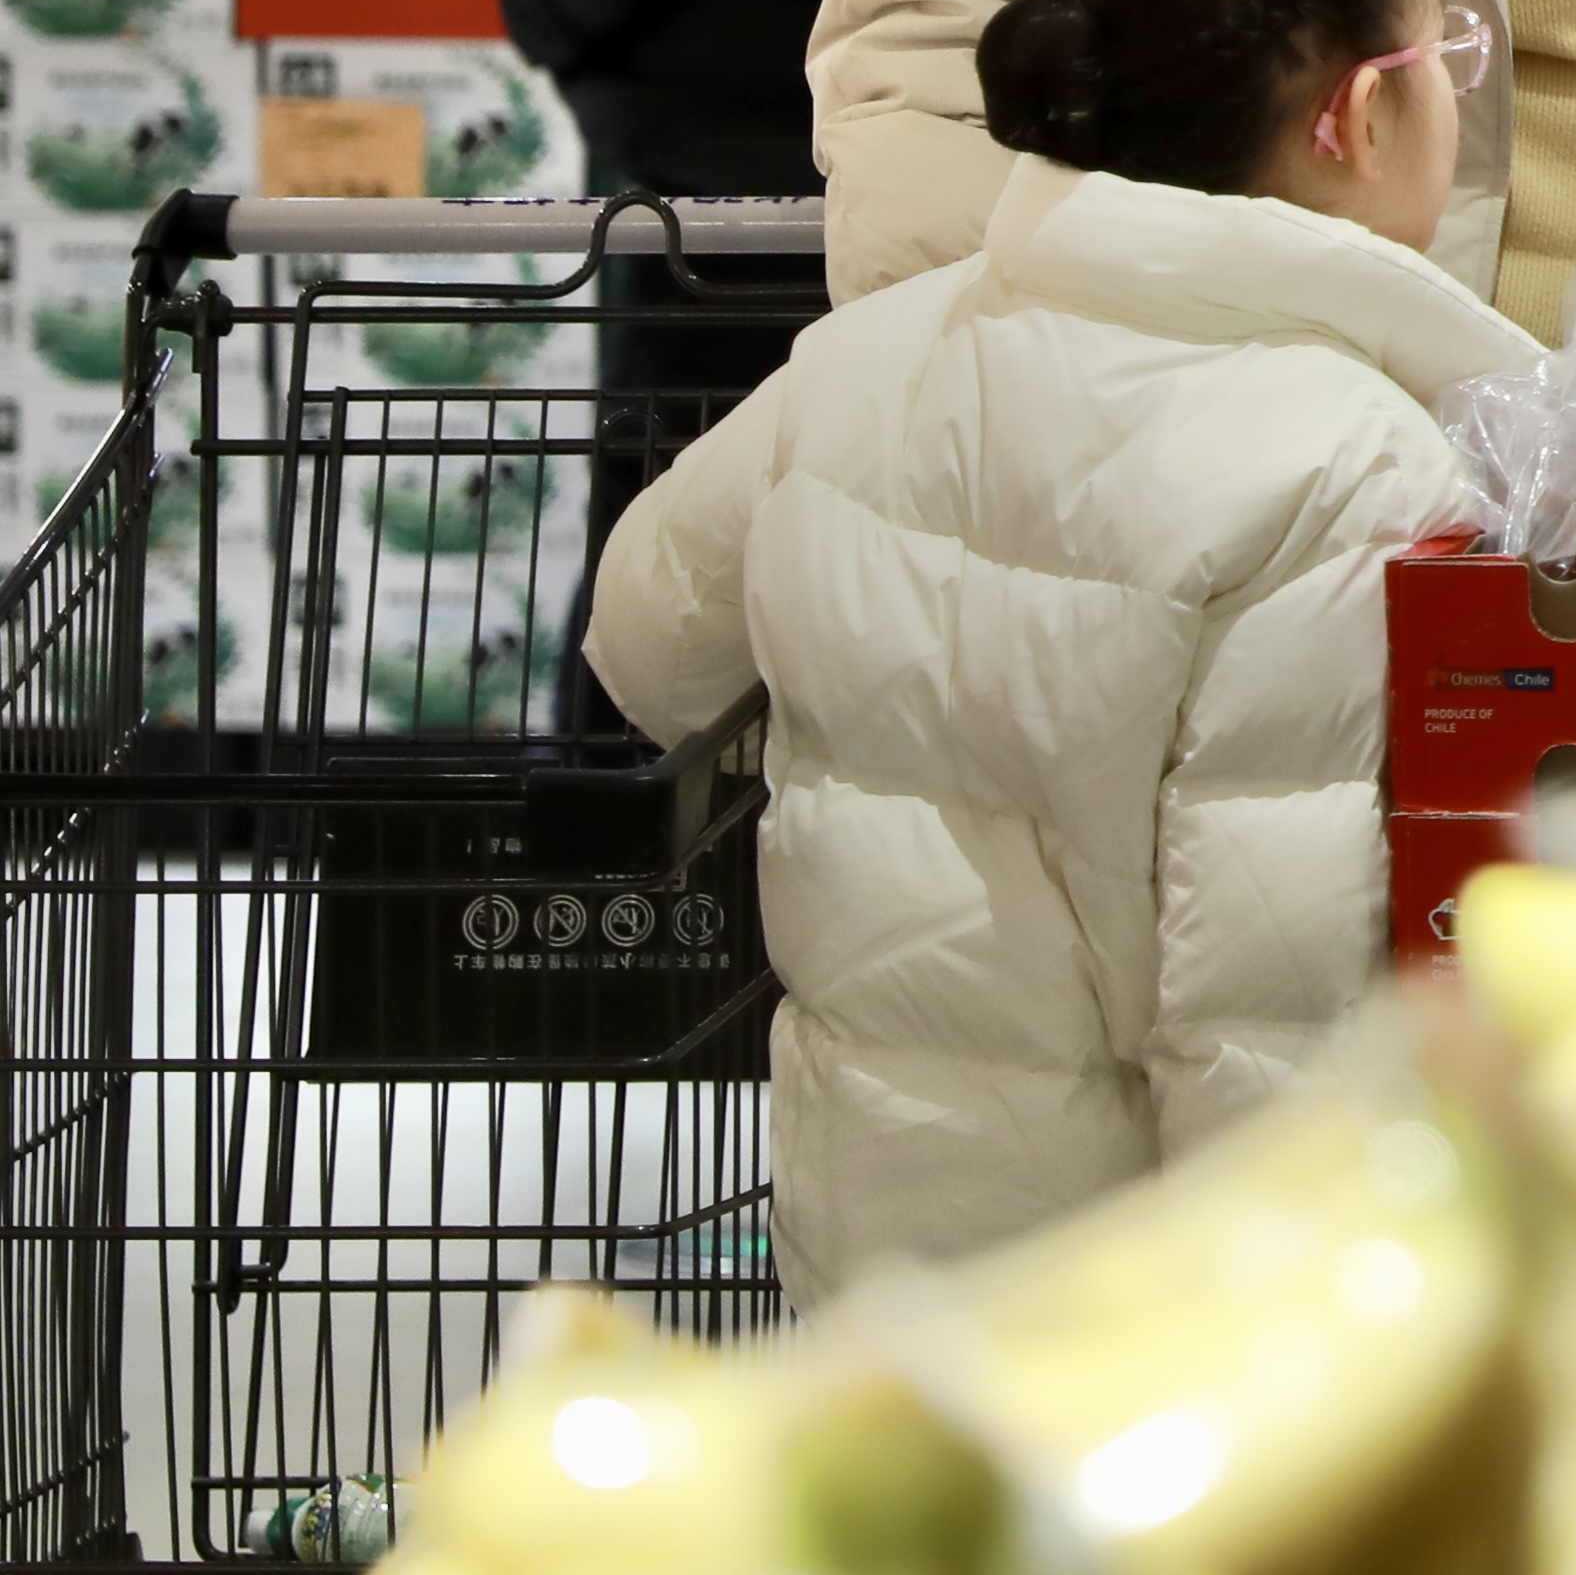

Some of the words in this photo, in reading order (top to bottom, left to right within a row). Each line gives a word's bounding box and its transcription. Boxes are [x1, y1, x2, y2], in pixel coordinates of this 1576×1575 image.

[1451, 672, 1502, 686] Cherries
[1514, 673, 1550, 686] Chile
[1425, 709, 1476, 719] PRODUCE
[1479, 709, 1493, 719] OF
[1425, 723, 1456, 733] CHILE
